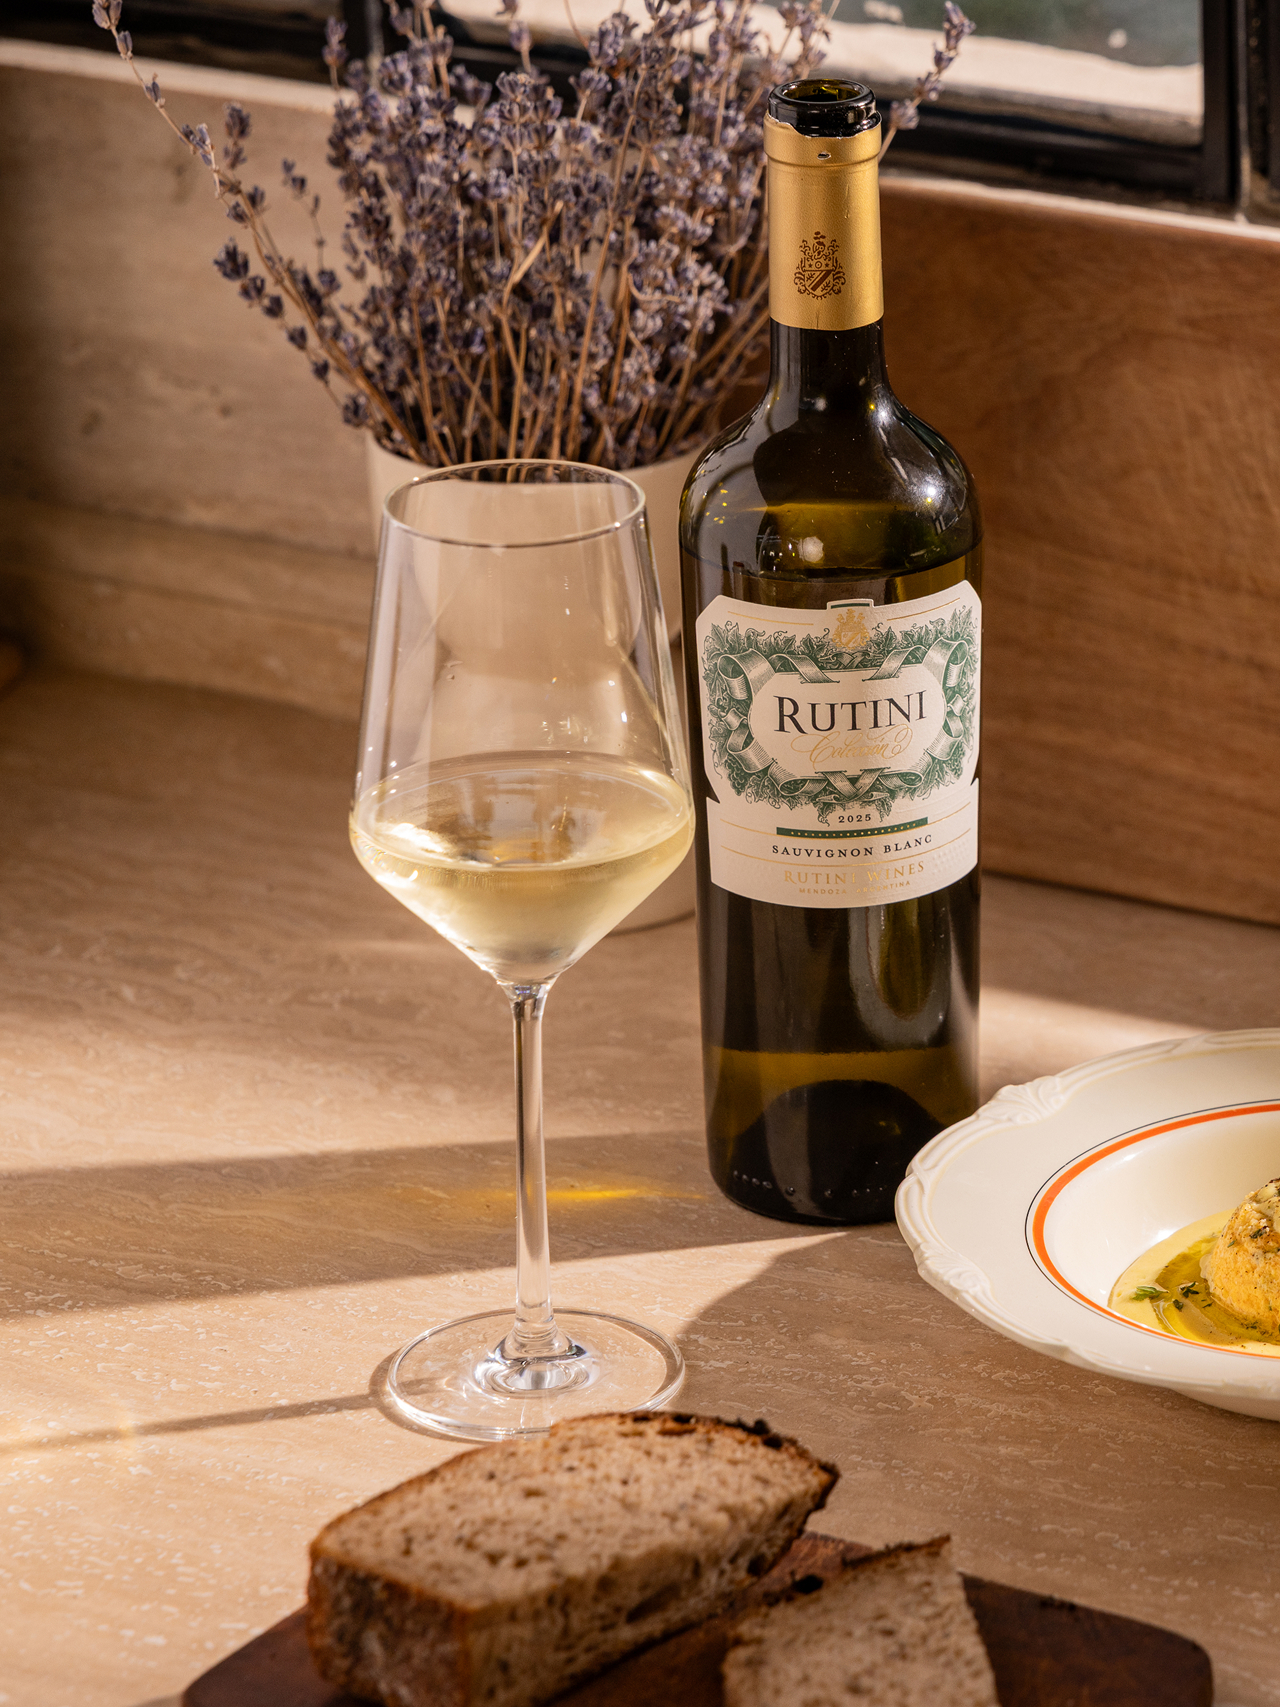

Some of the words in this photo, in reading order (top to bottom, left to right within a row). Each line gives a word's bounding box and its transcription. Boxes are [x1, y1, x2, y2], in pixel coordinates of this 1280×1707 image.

[773, 690, 927, 734] RUTINI
[838, 813, 872, 824] 2025
[772, 844, 874, 858] SAUVIGNON
[883, 834, 932, 853] BLANC
[784, 869, 857, 885] RUTINI
[867, 860, 924, 883] WINES
[799, 887, 847, 895] MENDOZA
